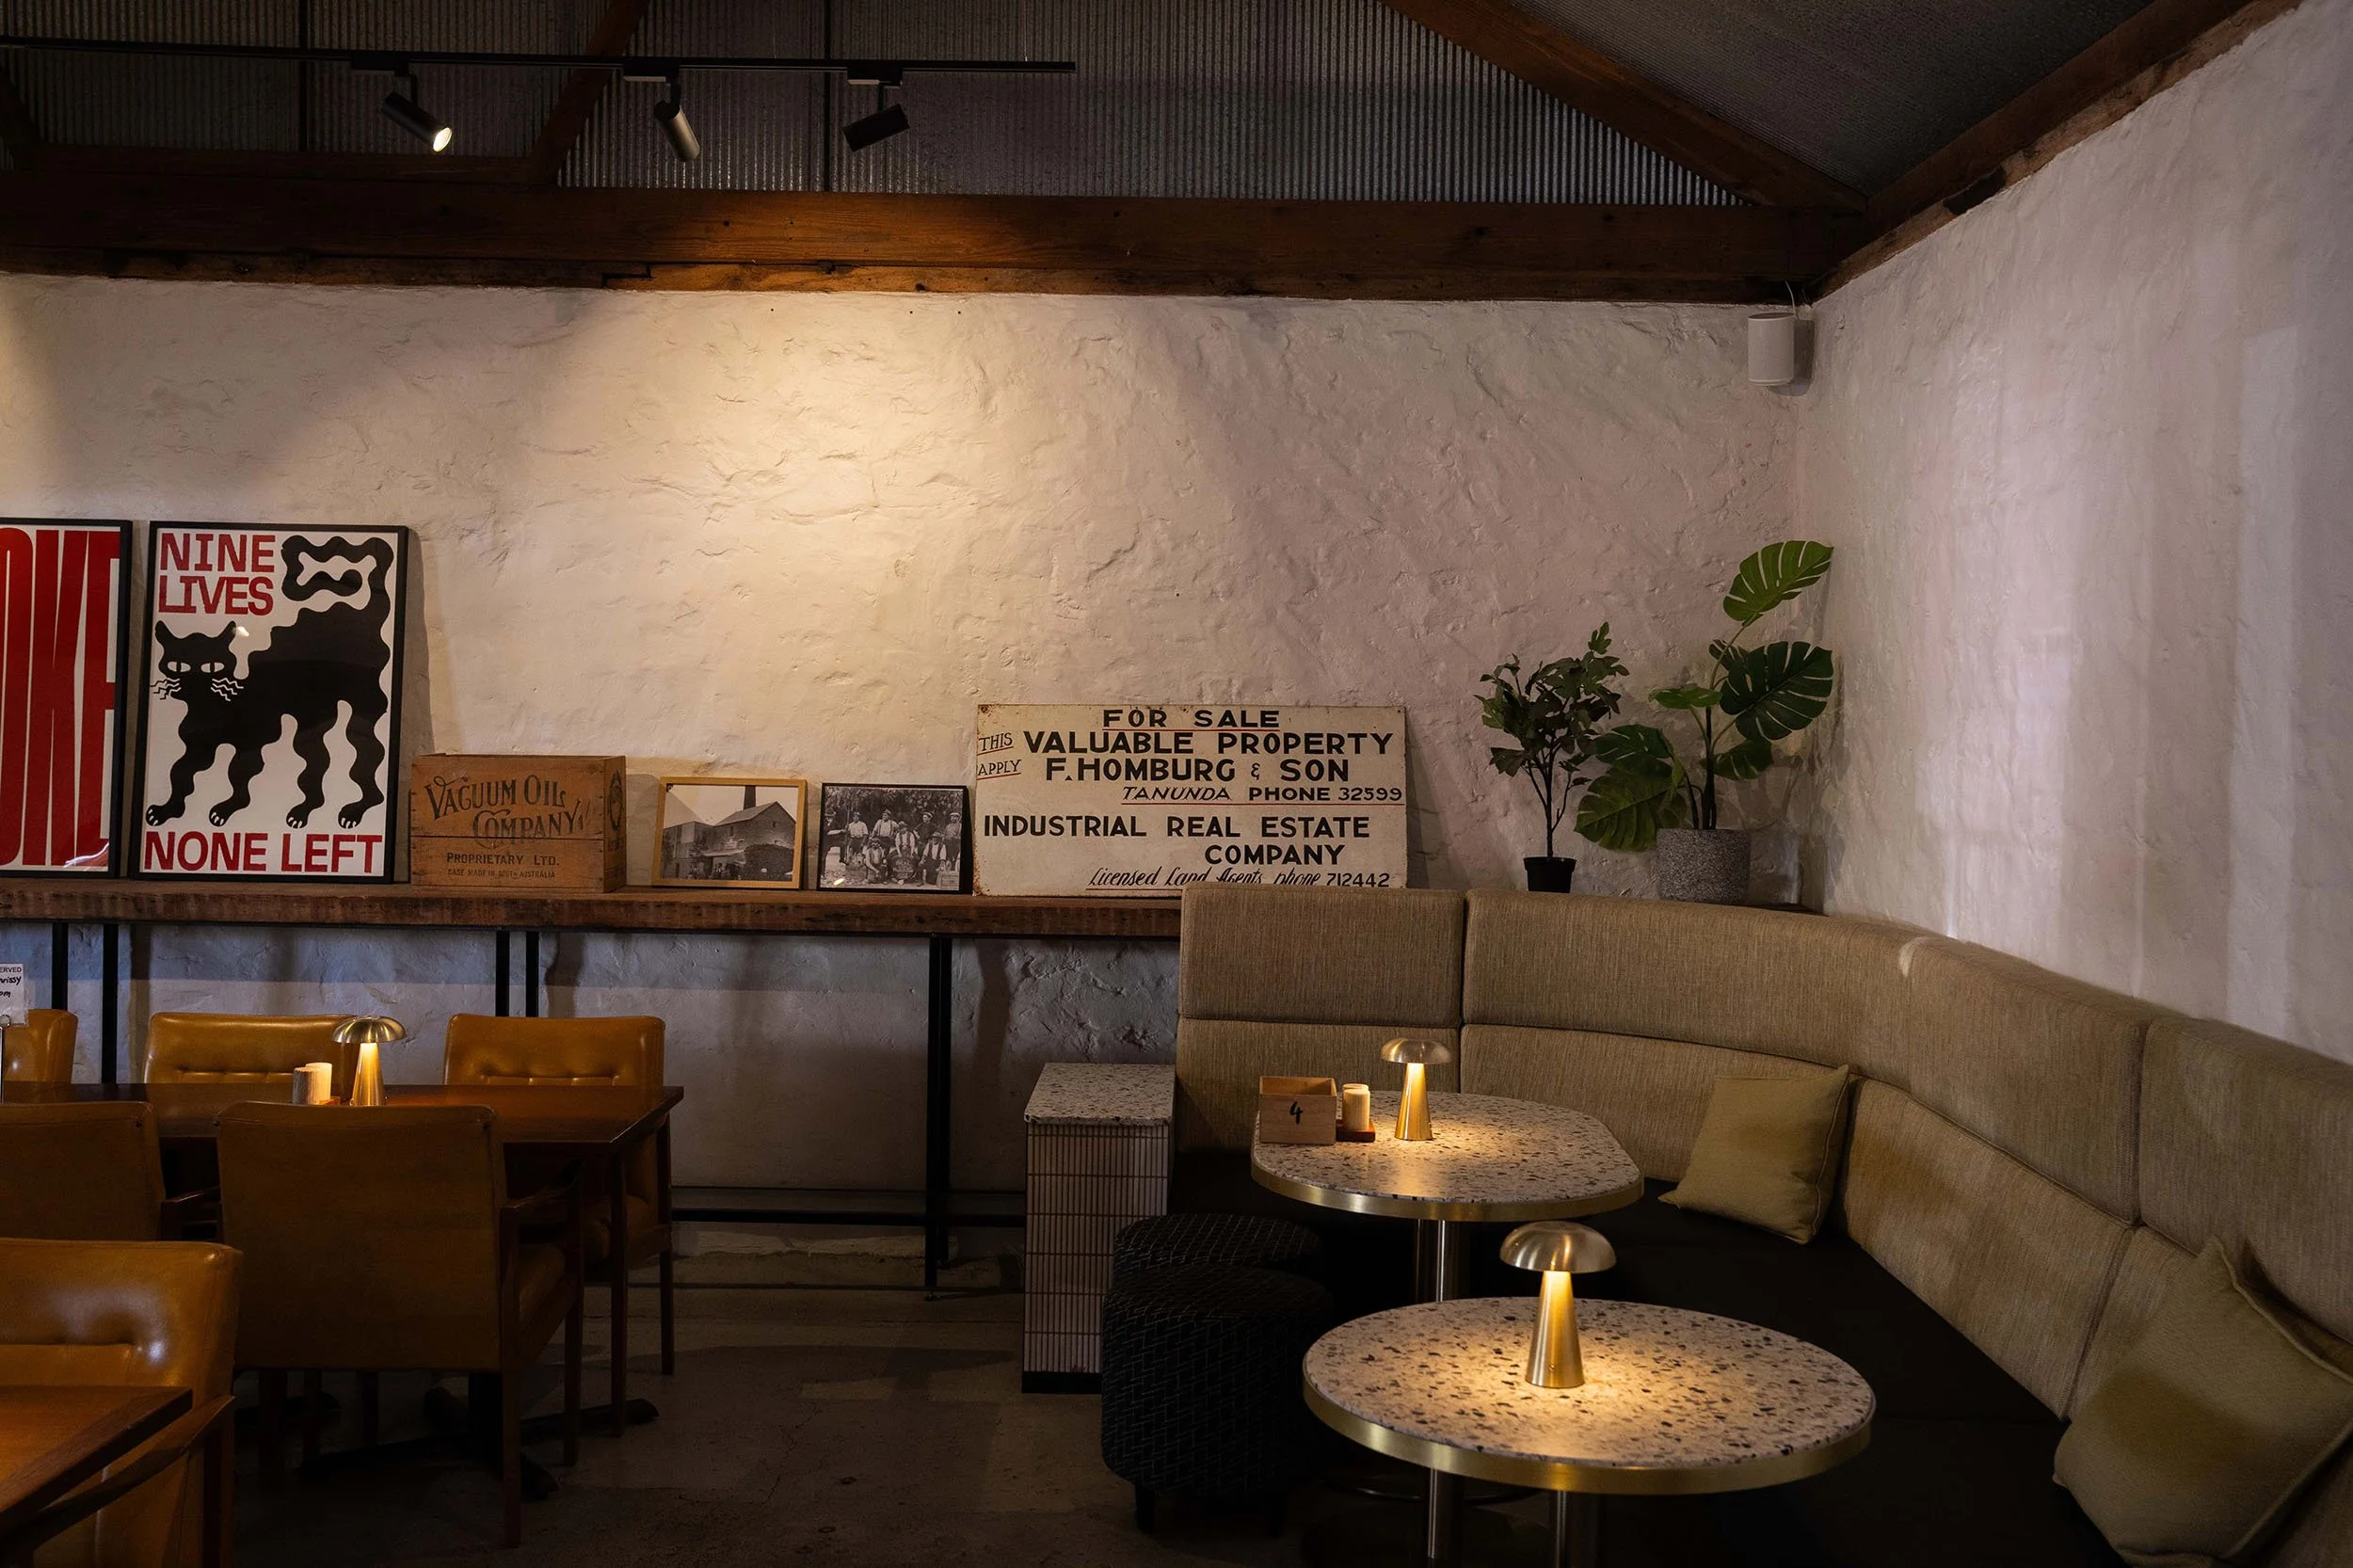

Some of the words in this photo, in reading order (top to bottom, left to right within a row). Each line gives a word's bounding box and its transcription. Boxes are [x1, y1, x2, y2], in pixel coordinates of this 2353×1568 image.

[160, 533, 276, 572] NINE
[158, 575, 274, 616] LIVES
[1103, 709, 1167, 728] FOR
[1193, 710, 1280, 728] SALE
[978, 732, 1014, 751] THIS
[1023, 731, 1193, 754] VALUABLE
[1218, 732, 1393, 754] PROPERTY
[977, 760, 1022, 776] APPLY
[1046, 758, 1236, 781] F.HOMBURG
[1250, 762, 1260, 780] &
[1280, 759, 1348, 781] SON
[424, 776, 517, 820] VACUUM
[1123, 786, 1232, 800] TANUNDA
[1249, 787, 1330, 801] PHONE
[1337, 787, 1402, 801] 32599
[473, 799, 584, 849] COMPANY
[984, 815, 1146, 837] INDUSTRIAL
[1167, 816, 1241, 838] REAL
[1261, 816, 1369, 838] ESTATE
[144, 831, 268, 871] NONE
[281, 834, 383, 873] LEFT
[446, 853, 523, 865] PROPRIETARY
[534, 855, 560, 866] LTD.
[1205, 844, 1345, 865] COMPANY
[1089, 866, 1162, 887] Licensed
[1165, 866, 1212, 886] Land
[1273, 867, 1322, 886] phone
[1326, 873, 1390, 888] 712442
[1290, 1101, 1303, 1124] 4
